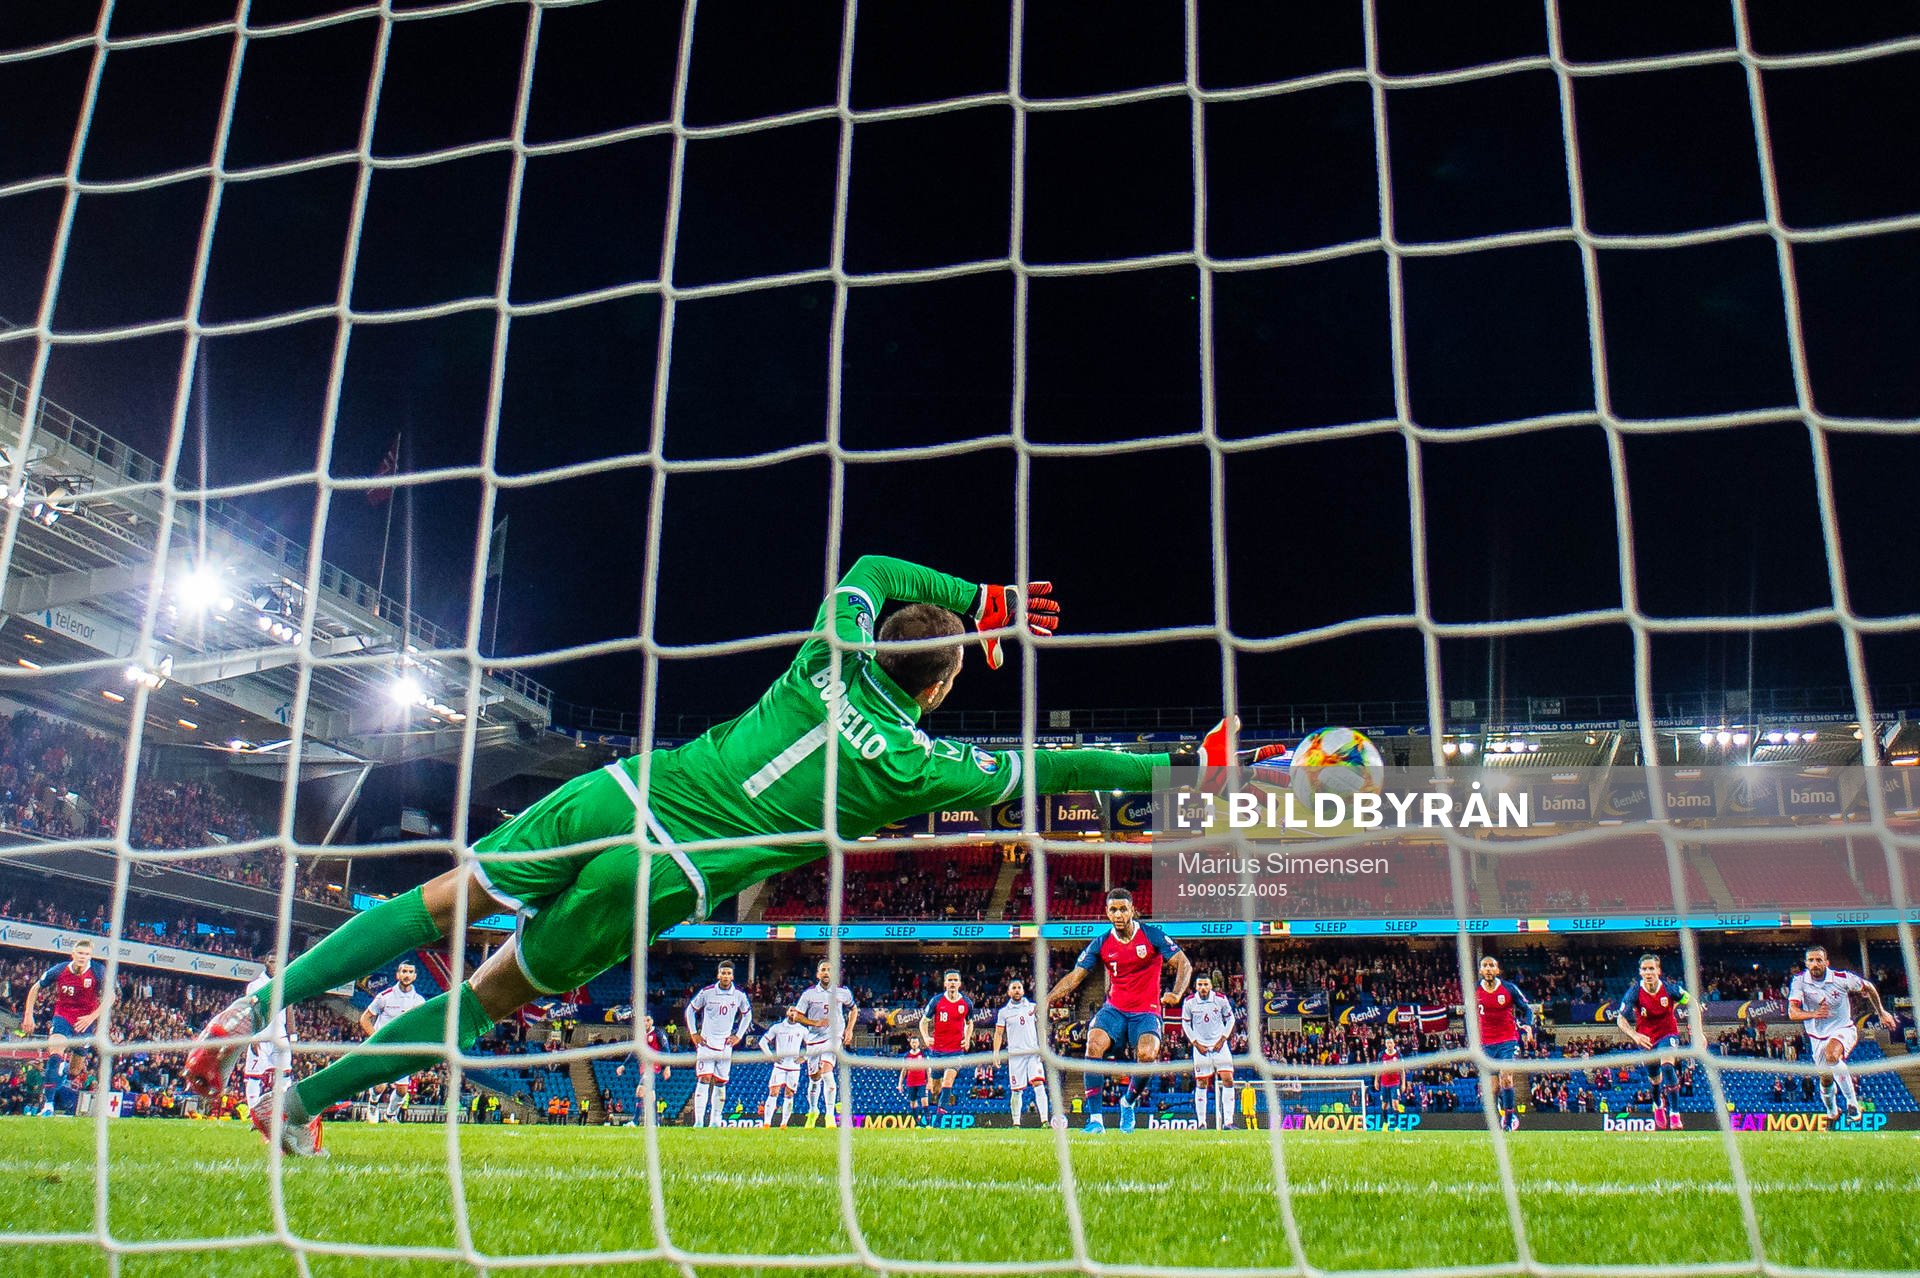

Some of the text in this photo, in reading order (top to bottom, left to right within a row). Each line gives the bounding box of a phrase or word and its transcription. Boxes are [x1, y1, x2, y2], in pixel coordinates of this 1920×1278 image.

[55, 610, 96, 641] telenor
[1613, 789, 1646, 809] Bendit
[1666, 792, 1712, 808] bama
[1790, 789, 1836, 804] bama
[1542, 795, 1586, 811] bama
[1128, 802, 1160, 819] Bendit
[1644, 916, 1677, 927] SLEEP
[1718, 914, 1750, 926] SLEEP
[1836, 912, 1869, 923] SLEEP
[1201, 923, 1232, 934] SLEEP
[1314, 922, 1347, 932] SLEEP
[1385, 921, 1417, 931] SLEEP
[1572, 919, 1605, 930] SLEEP
[711, 926, 743, 937] SLEEP
[819, 926, 849, 937] SLP
[885, 926, 916, 937] SLEEP
[952, 926, 984, 936] SLEEP
[1062, 925, 1094, 936] SLEEP
[1109, 961, 1118, 977] 7
[549, 1003, 579, 1019] Bendit
[719, 1005, 728, 1016] 10
[823, 1004, 829, 1015] 5
[1350, 1005, 1381, 1022] Bendit
[1478, 1004, 1485, 1015] 2
[1748, 1000, 1780, 1018] Bendit
[939, 1011, 948, 1022] 18
[1019, 1015, 1025, 1026] 8
[1203, 1013, 1210, 1023] 6
[251, 1058, 258, 1071] 7
[1011, 1075, 1017, 1085] 8
[1149, 1115, 1198, 1131] bama
[1603, 1113, 1656, 1132] bama
